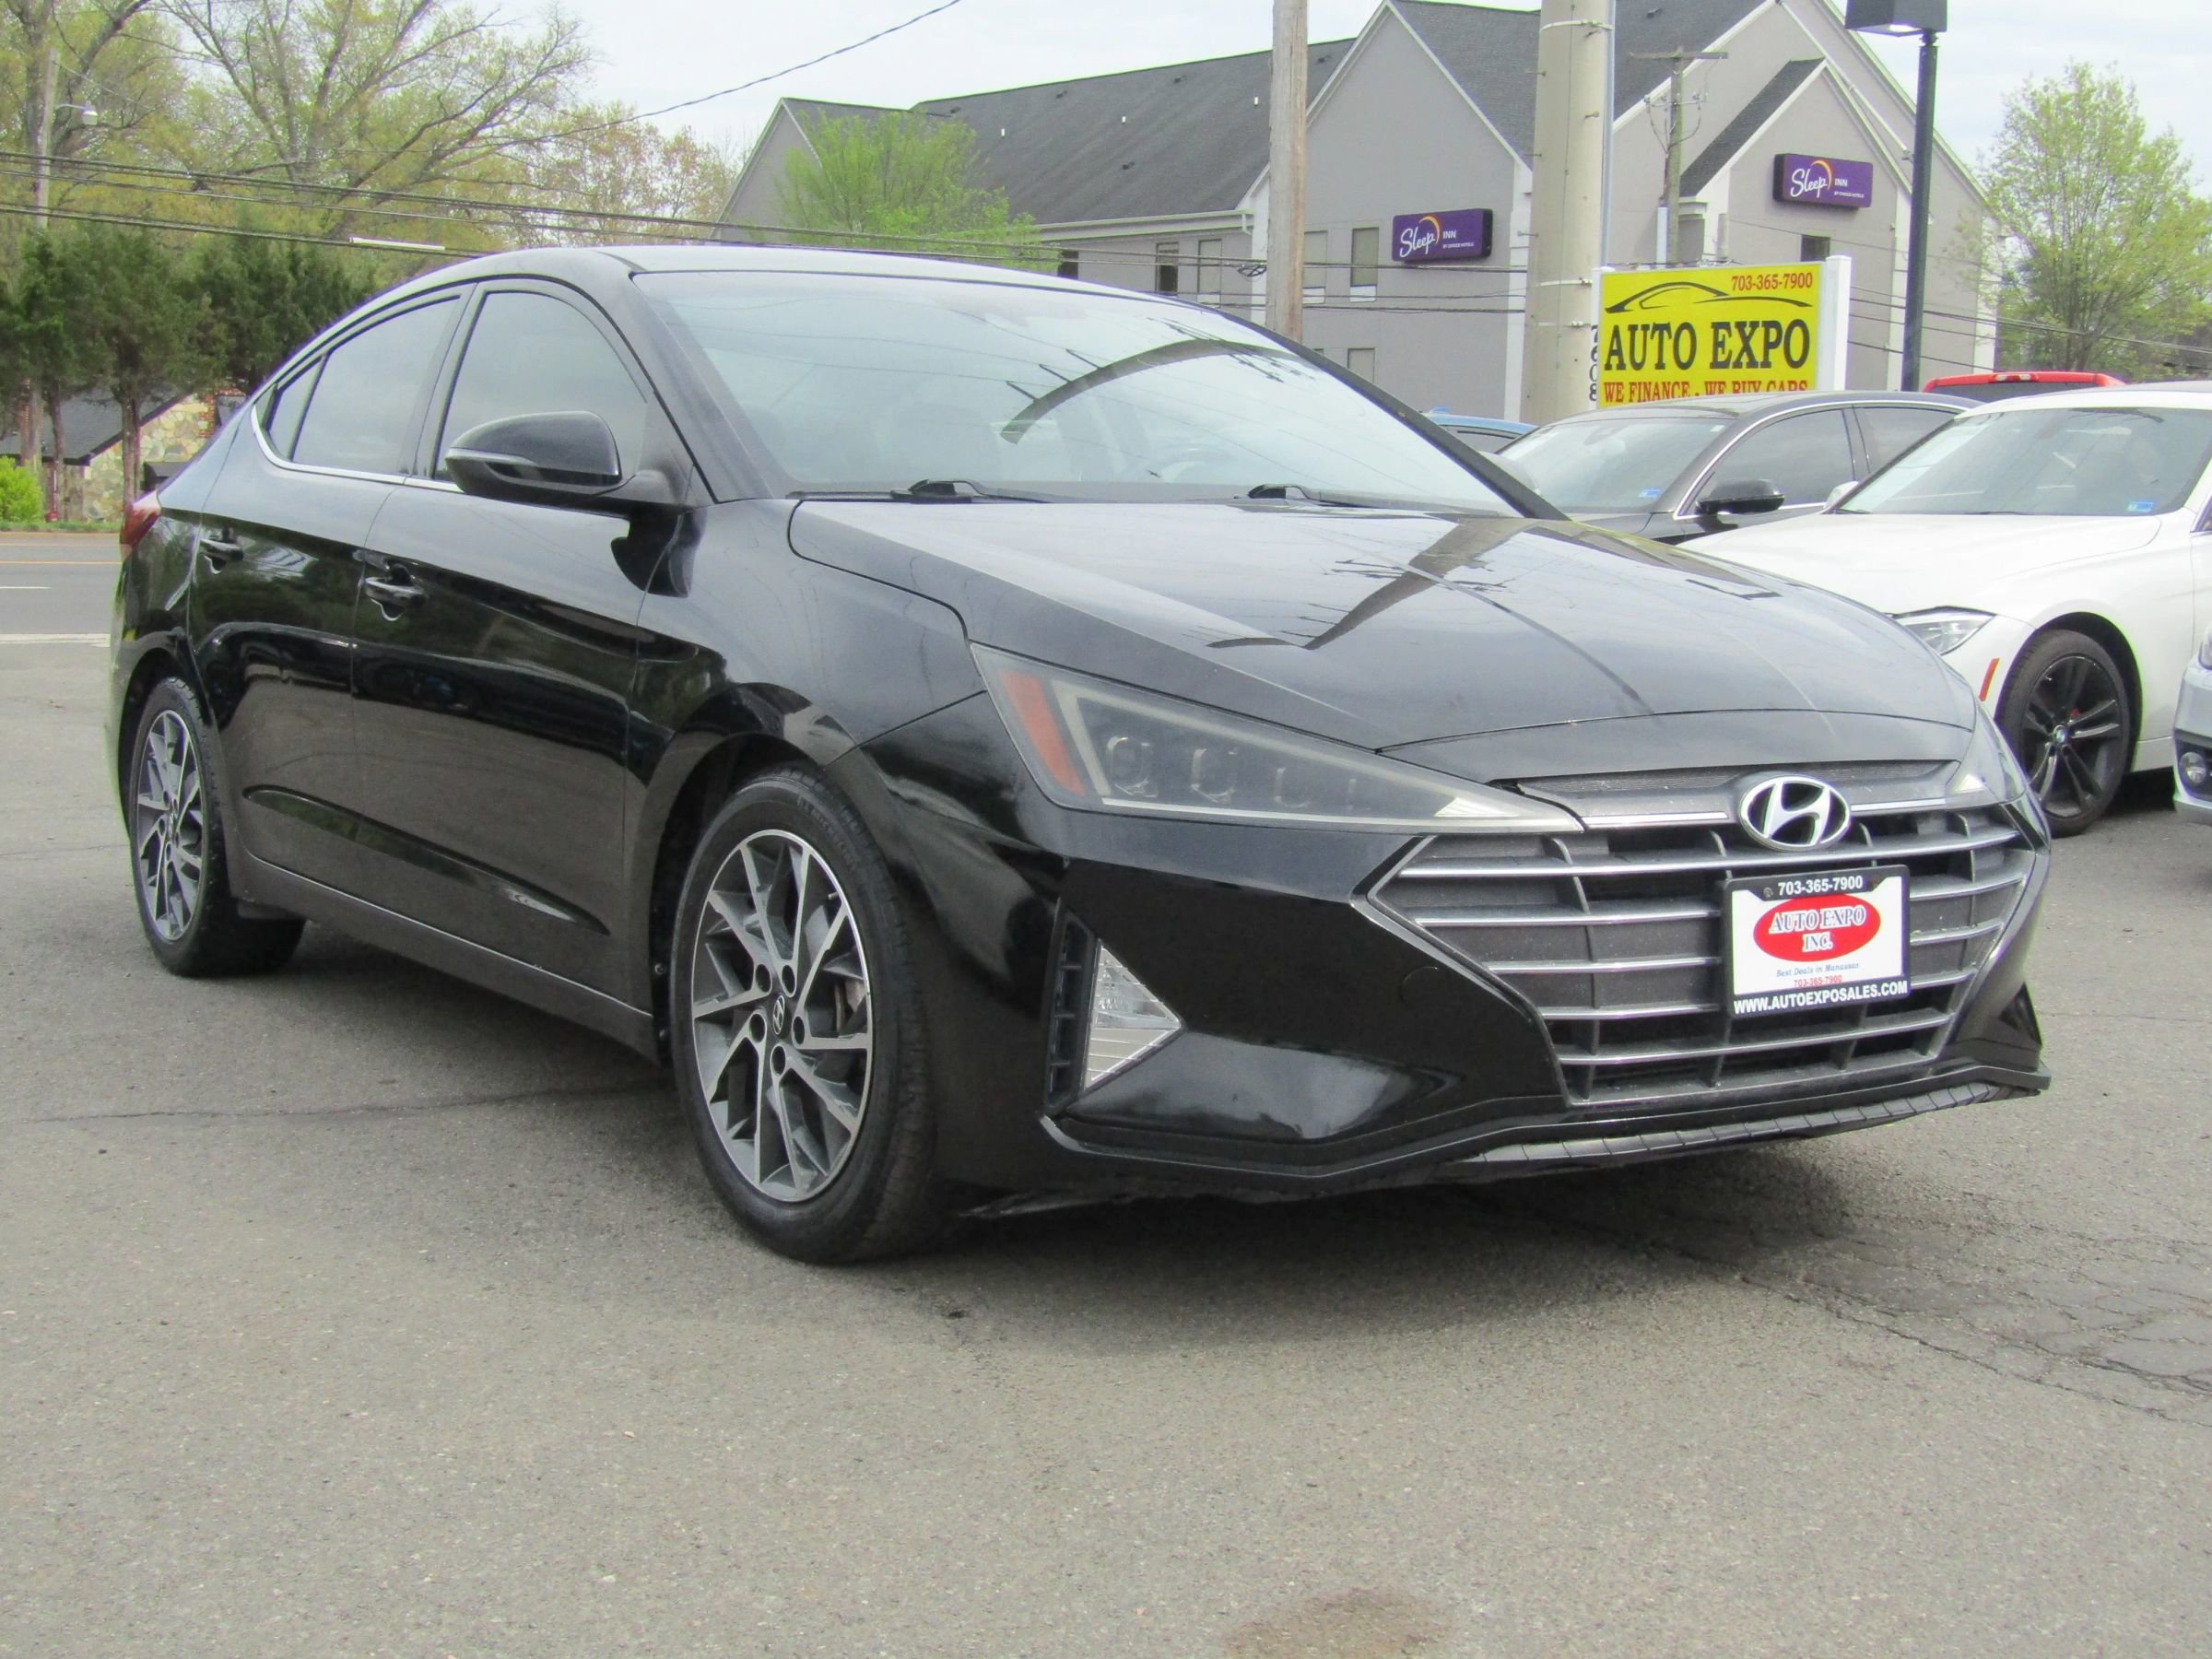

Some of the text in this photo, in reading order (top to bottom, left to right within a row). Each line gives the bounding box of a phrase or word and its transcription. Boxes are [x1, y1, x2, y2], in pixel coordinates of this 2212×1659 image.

[1790, 168, 1848, 198] Sleep INN
[1399, 226, 1456, 257] Sleep INN
[1731, 273, 1813, 291] 703-365-7900
[1605, 319, 1810, 371] AUTO EXPO
[1604, 382, 1624, 403] WE
[1629, 381, 1689, 403] FINANCE
[1778, 876, 1863, 896] 703-365-7900
[1770, 905, 1865, 933] AUTO EXPO
[1803, 933, 1832, 952] INC.
[1776, 970, 1792, 978] Best
[1794, 966, 1813, 976] Deals
[1794, 974, 1842, 988] 703-365-7900
[1734, 981, 1908, 1014] WWW.AUTOEXPOSALES.COM
